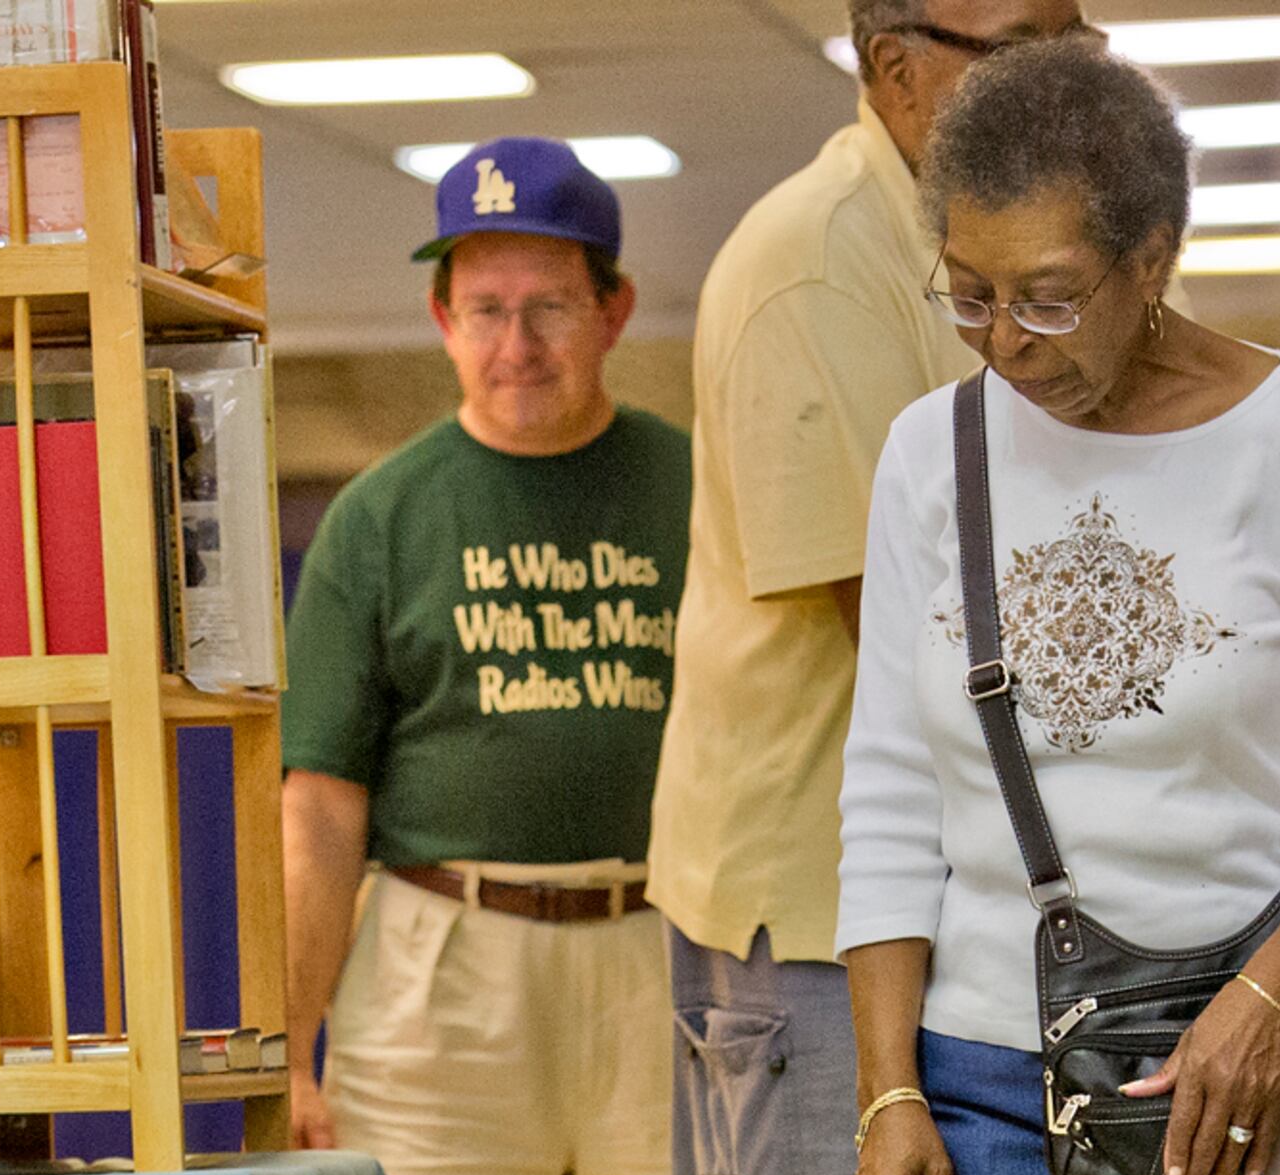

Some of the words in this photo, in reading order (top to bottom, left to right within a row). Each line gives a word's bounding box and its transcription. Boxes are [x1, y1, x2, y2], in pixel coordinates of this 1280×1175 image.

[472, 158, 516, 215] LA
[463, 545, 508, 591] He
[509, 543, 588, 592] Who
[591, 540, 660, 589] Dies
[453, 600, 537, 655] With
[536, 602, 593, 651] The
[594, 598, 676, 656] Most
[477, 661, 582, 715] Radios
[582, 659, 665, 712] Wins
